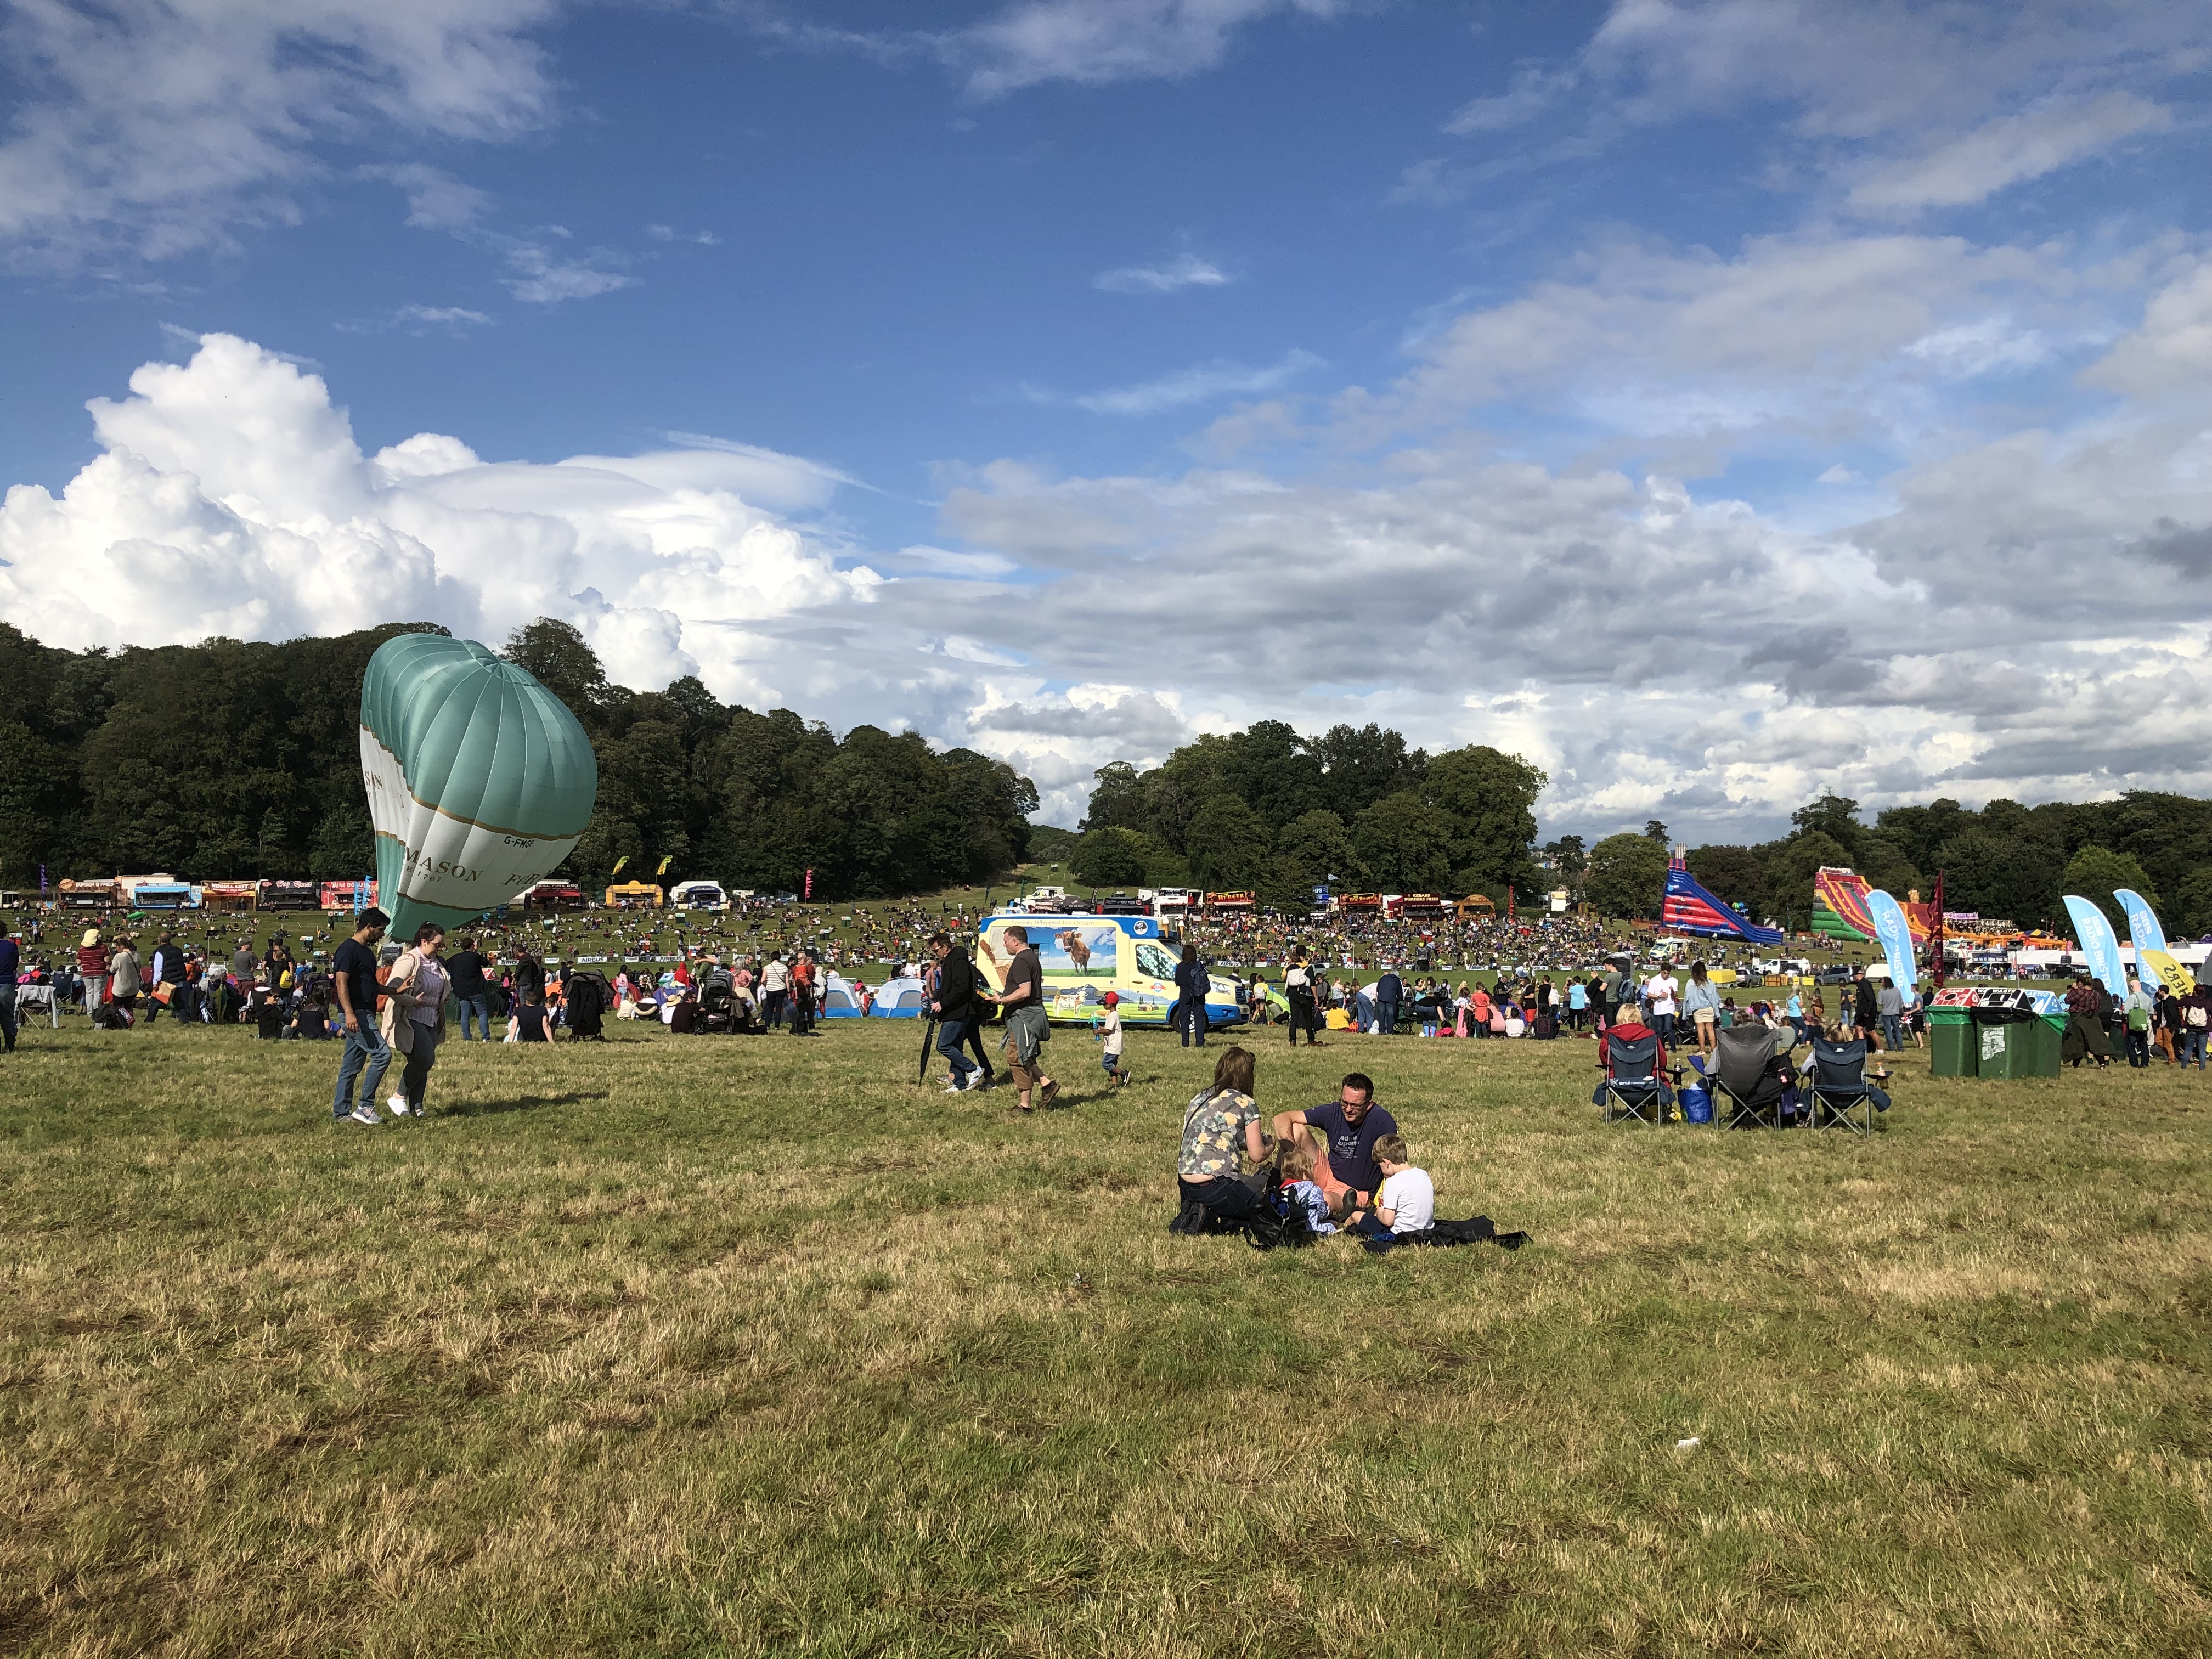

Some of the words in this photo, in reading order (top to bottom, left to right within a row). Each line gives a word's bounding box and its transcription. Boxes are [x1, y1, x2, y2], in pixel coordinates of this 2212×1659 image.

[406, 847, 484, 882] MASON
[2081, 917, 2100, 949] RADIO
[2130, 913, 2147, 951] RADIO
